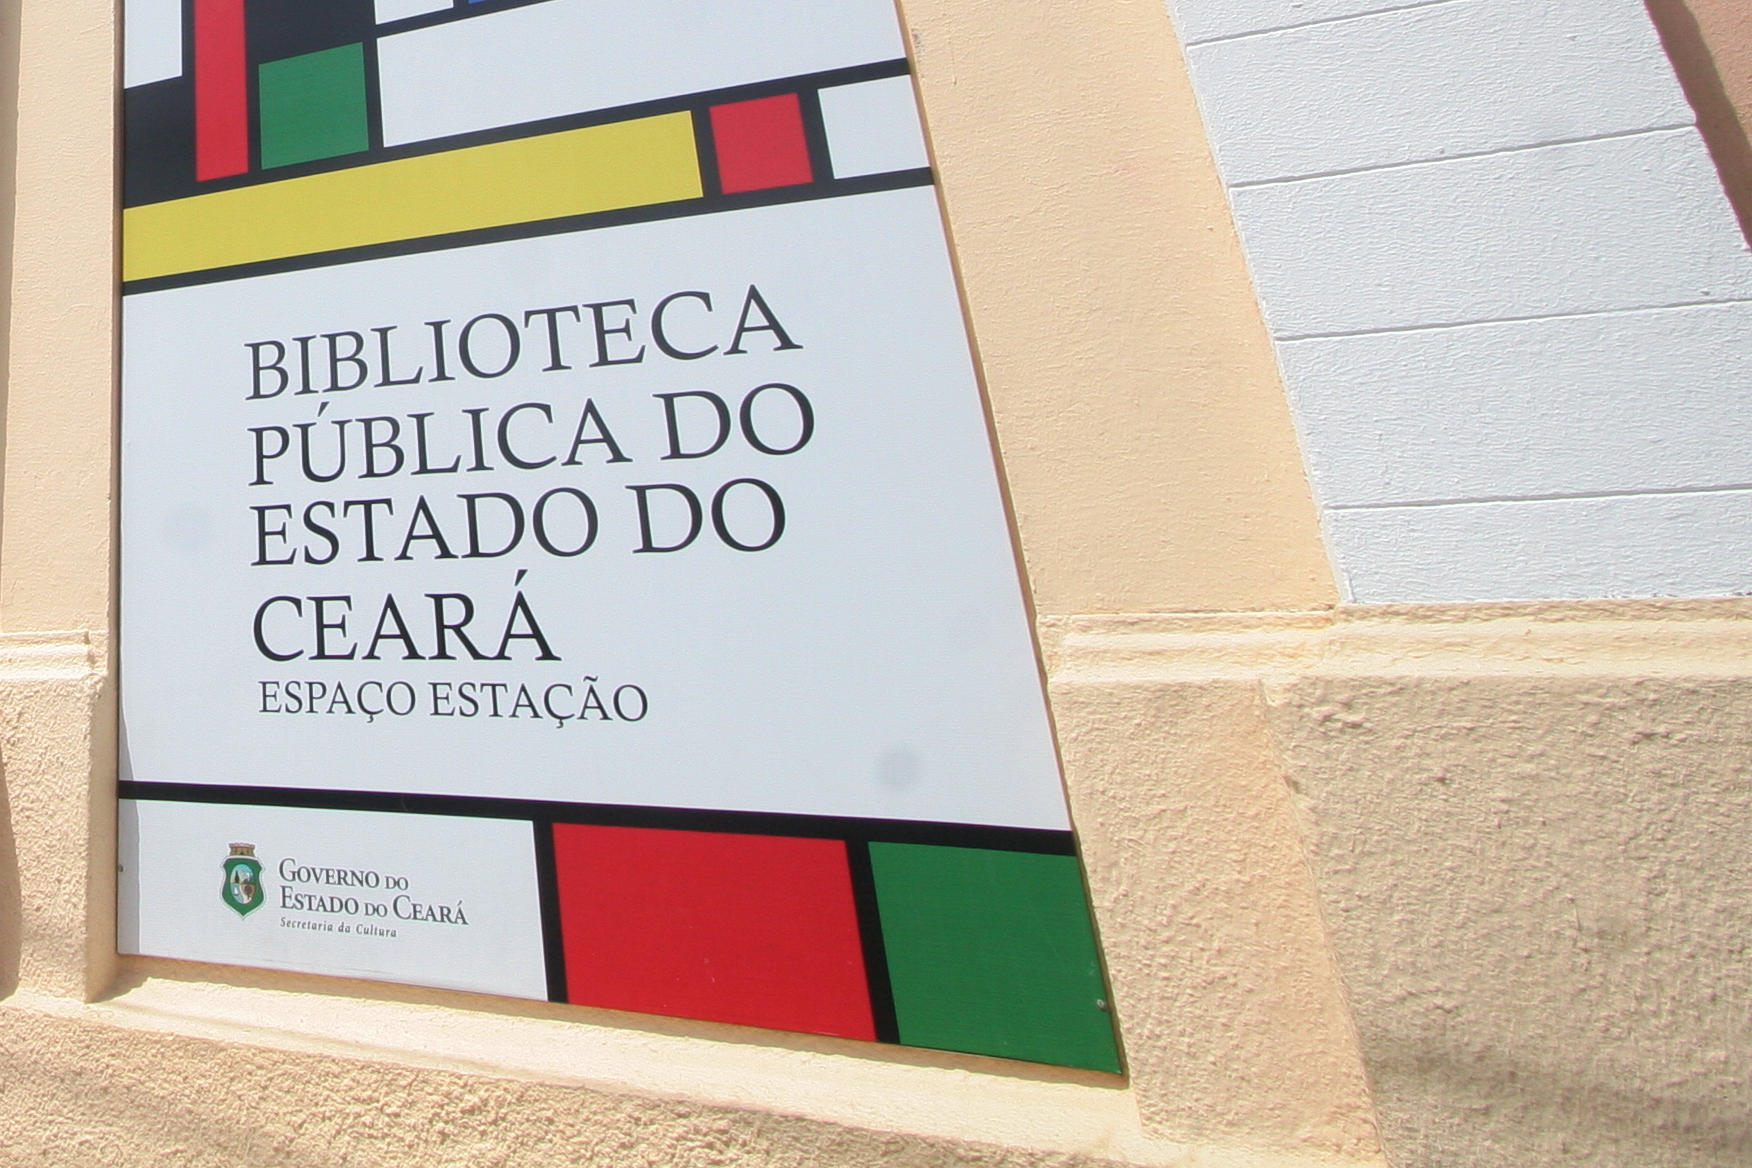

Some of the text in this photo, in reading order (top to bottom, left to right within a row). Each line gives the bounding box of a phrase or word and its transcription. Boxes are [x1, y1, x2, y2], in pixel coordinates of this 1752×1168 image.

[244, 283, 804, 401] BIBLIOTECA
[246, 382, 815, 487] PÚBLICA DO
[248, 477, 787, 567] ESTADO DO
[252, 568, 562, 662] CEARÁ
[258, 675, 648, 729] ESPAÇO ESTAÇÃO
[279, 916, 398, 938] Secretaria da Cultura
